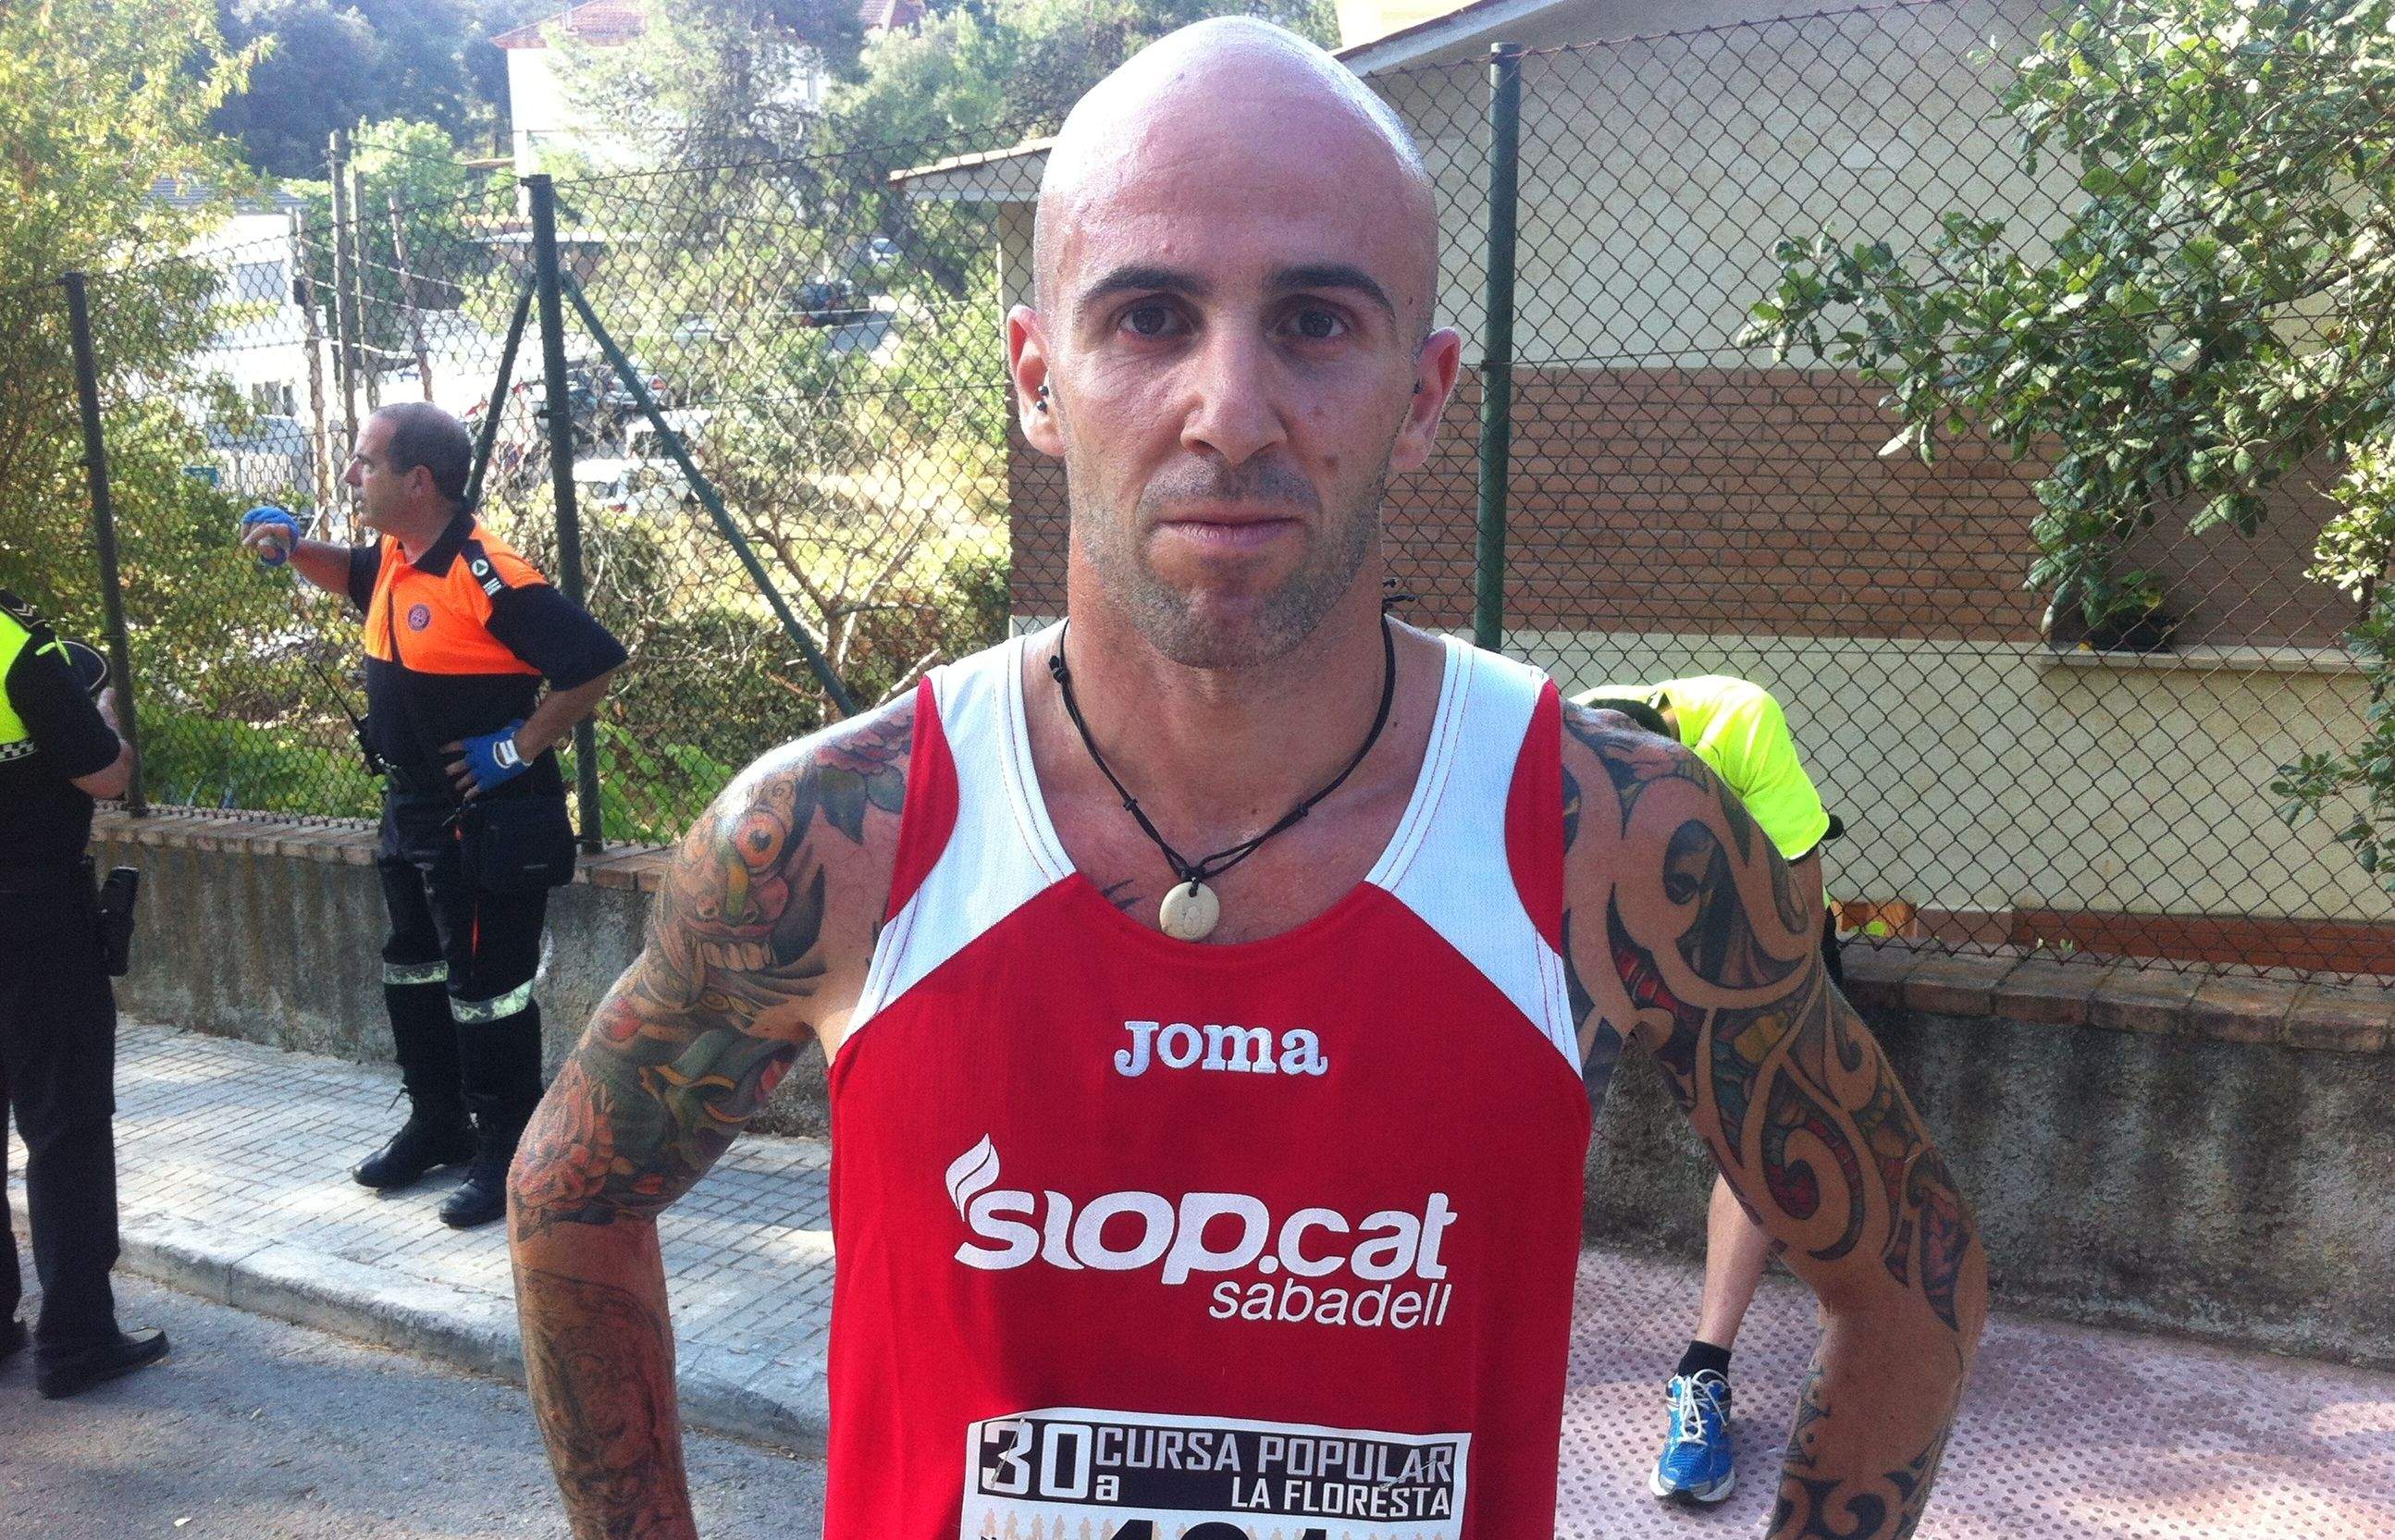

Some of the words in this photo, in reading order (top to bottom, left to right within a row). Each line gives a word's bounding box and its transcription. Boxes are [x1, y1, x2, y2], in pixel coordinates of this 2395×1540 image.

[1114, 1020, 1328, 1078] Joma
[1208, 1278, 1452, 1330] sabadell
[981, 1421, 1093, 1499] 30
[1095, 1426, 1241, 1472] CURSA
[1257, 1435, 1453, 1484] POPULAR
[1231, 1476, 1272, 1509] LA
[1283, 1479, 1451, 1518] FLORESTA
